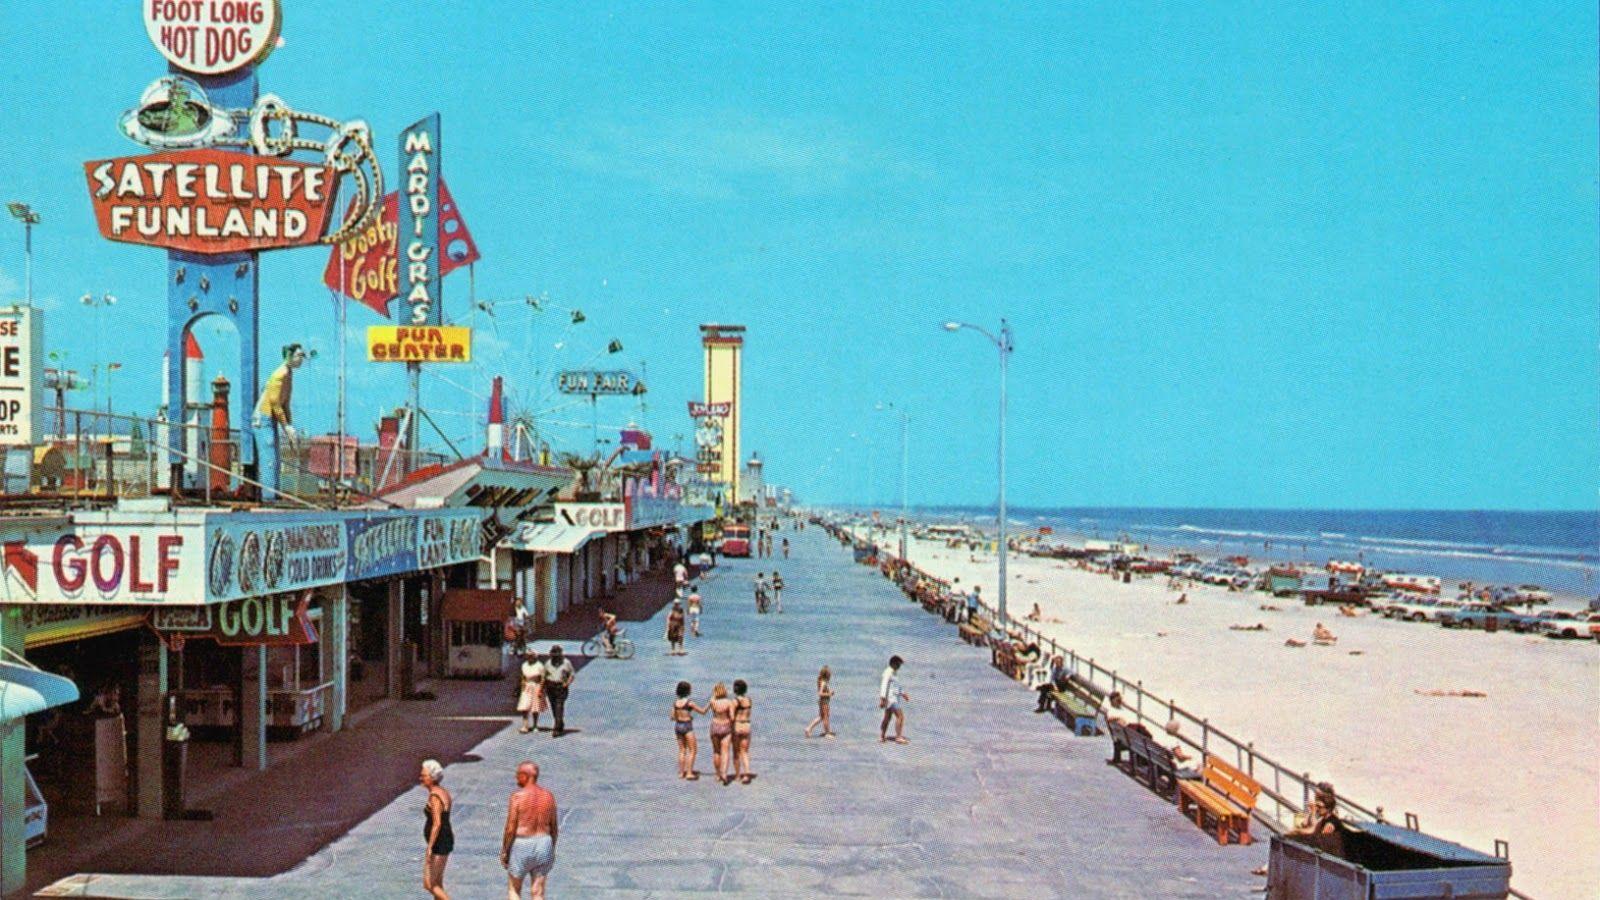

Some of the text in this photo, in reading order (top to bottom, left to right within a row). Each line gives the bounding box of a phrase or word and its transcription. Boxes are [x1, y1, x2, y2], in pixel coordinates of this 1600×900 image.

[152, 0, 263, 24] FOOT LONG
[160, 25, 252, 67] HOT DOG
[93, 162, 326, 201] SATELLITE
[111, 206, 308, 239] FUNLAND
[404, 130, 433, 325] MARDI GRAS
[351, 256, 397, 300] Golf
[371, 343, 465, 359] CENTER
[396, 328, 442, 343] FUN
[559, 373, 628, 391] FUN FAIR
[575, 508, 623, 526] GOLF
[52, 534, 184, 593] GOLF
[220, 594, 296, 636] GOLF
